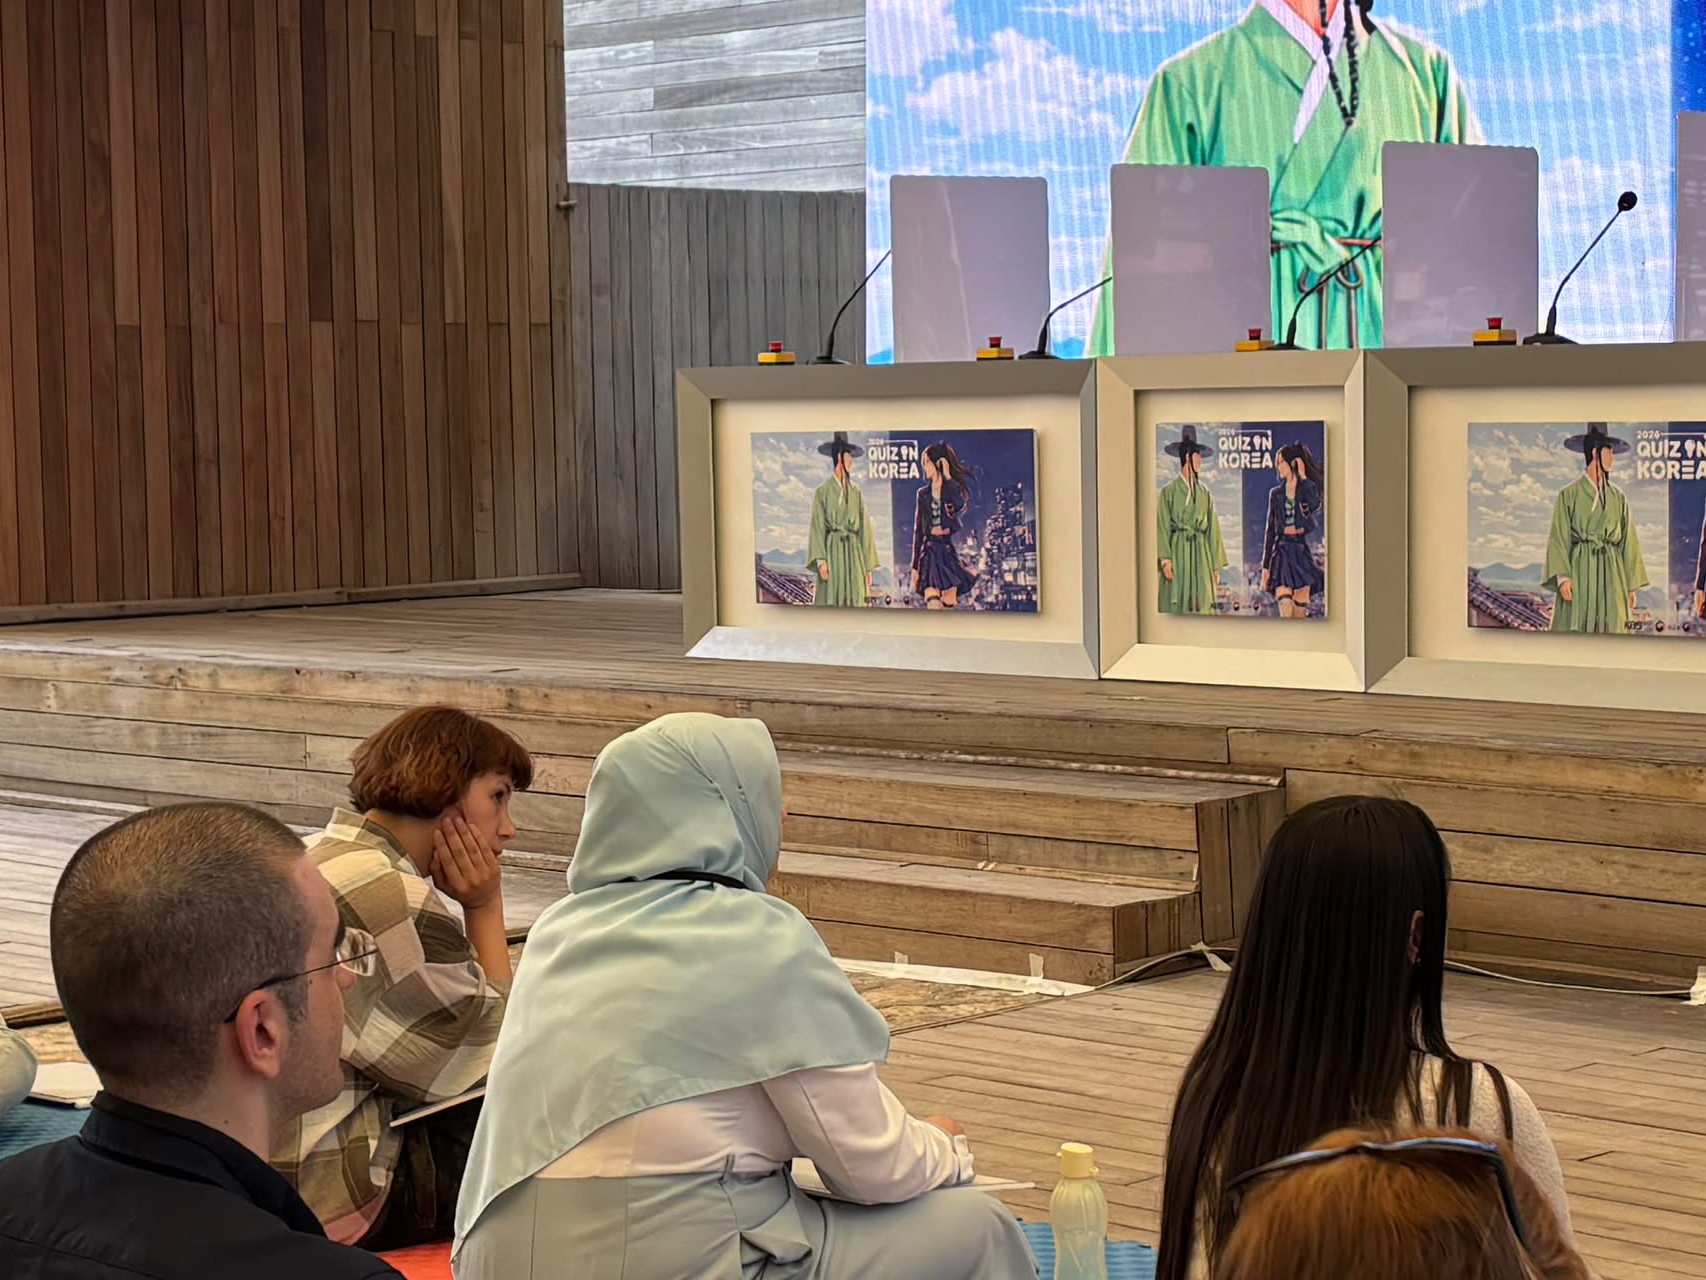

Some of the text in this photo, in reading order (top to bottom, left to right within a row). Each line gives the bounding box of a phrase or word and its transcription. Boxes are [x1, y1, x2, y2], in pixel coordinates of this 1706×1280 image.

[1218, 435, 1251, 451] QUIZ
[1636, 439, 1682, 458] QUIZ
[868, 445, 899, 461] QUIZ
[1218, 451, 1273, 469] KOREA
[868, 462, 920, 479] KOREA
